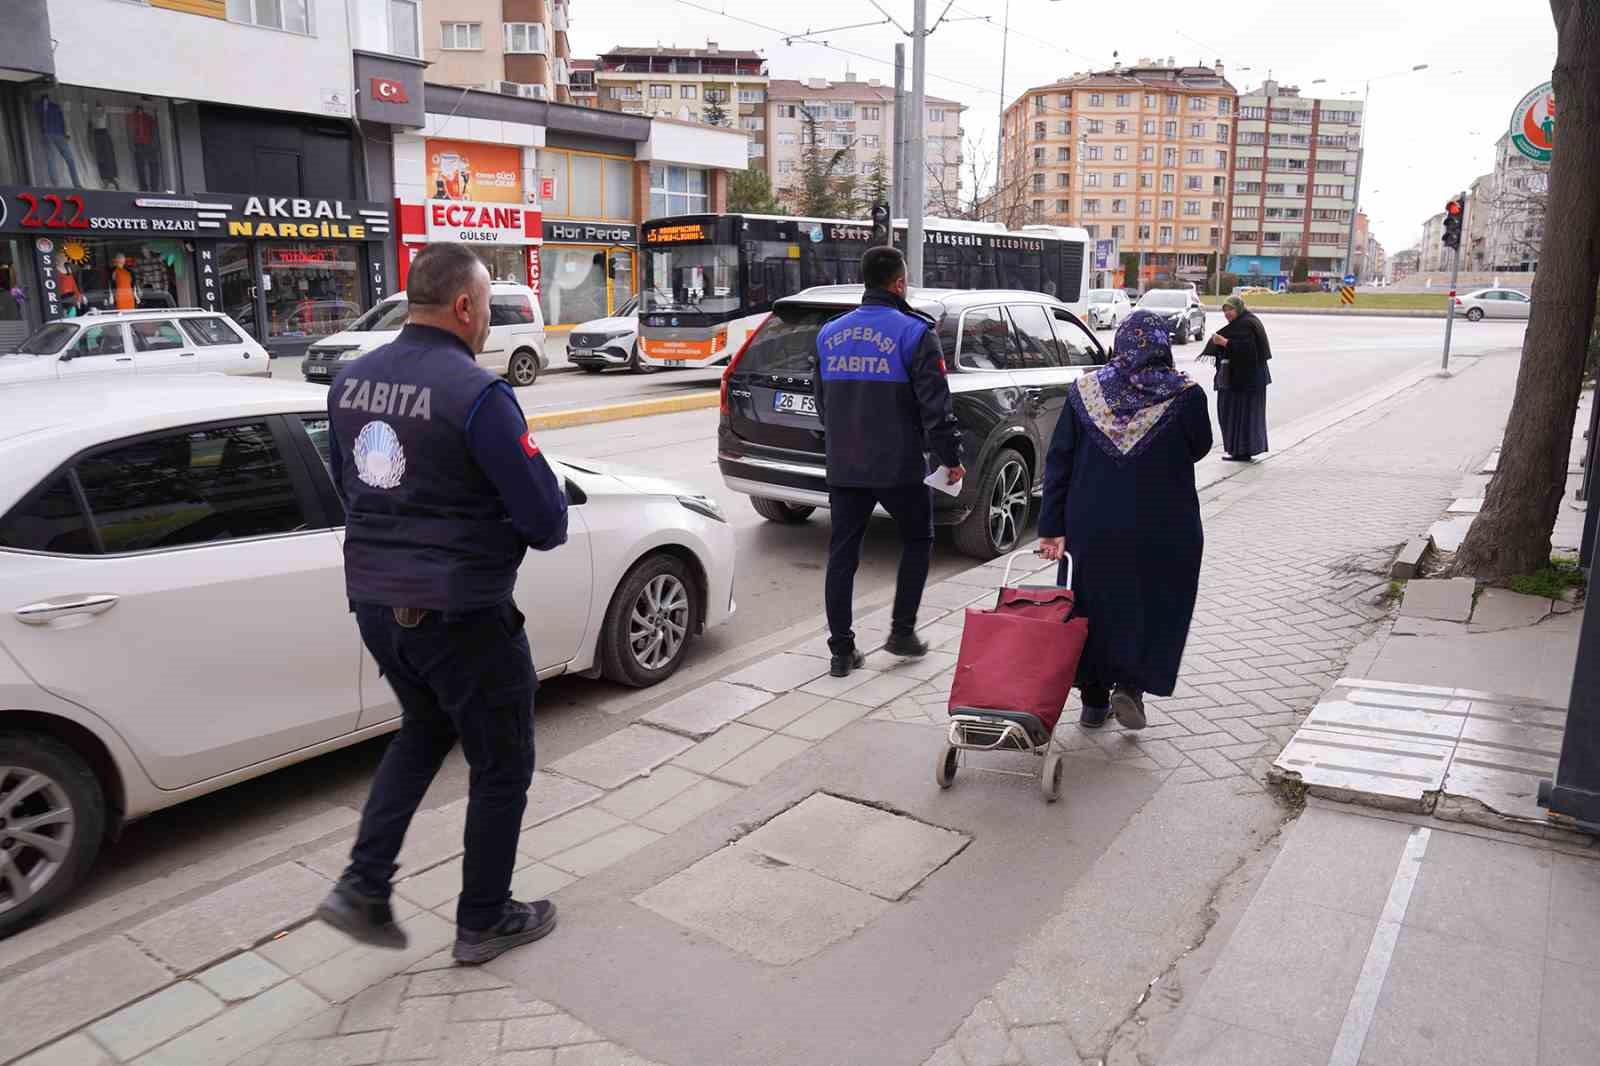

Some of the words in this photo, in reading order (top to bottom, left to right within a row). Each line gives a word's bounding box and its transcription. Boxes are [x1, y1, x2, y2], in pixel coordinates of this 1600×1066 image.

[543, 181, 553, 195] E
[16, 192, 89, 229] 222
[90, 217, 148, 230] SOSYETE
[152, 219, 196, 231] PAZARI
[244, 197, 352, 219] AKBAL
[431, 204, 521, 229] ECZANE
[228, 221, 366, 239] NARGİLE
[460, 231, 498, 241] GÜLSEV
[585, 227, 631, 240] Perde
[831, 226, 901, 242] ESKİŞR
[373, 262, 383, 304] TÜTÜ
[530, 250, 540, 294] ECZ
[42, 255, 58, 314] STORE
[823, 327, 897, 354] TEPEBAŞI
[827, 356, 890, 374] ZABITA
[339, 378, 432, 420] ZABITA
[780, 394, 795, 408] 26
